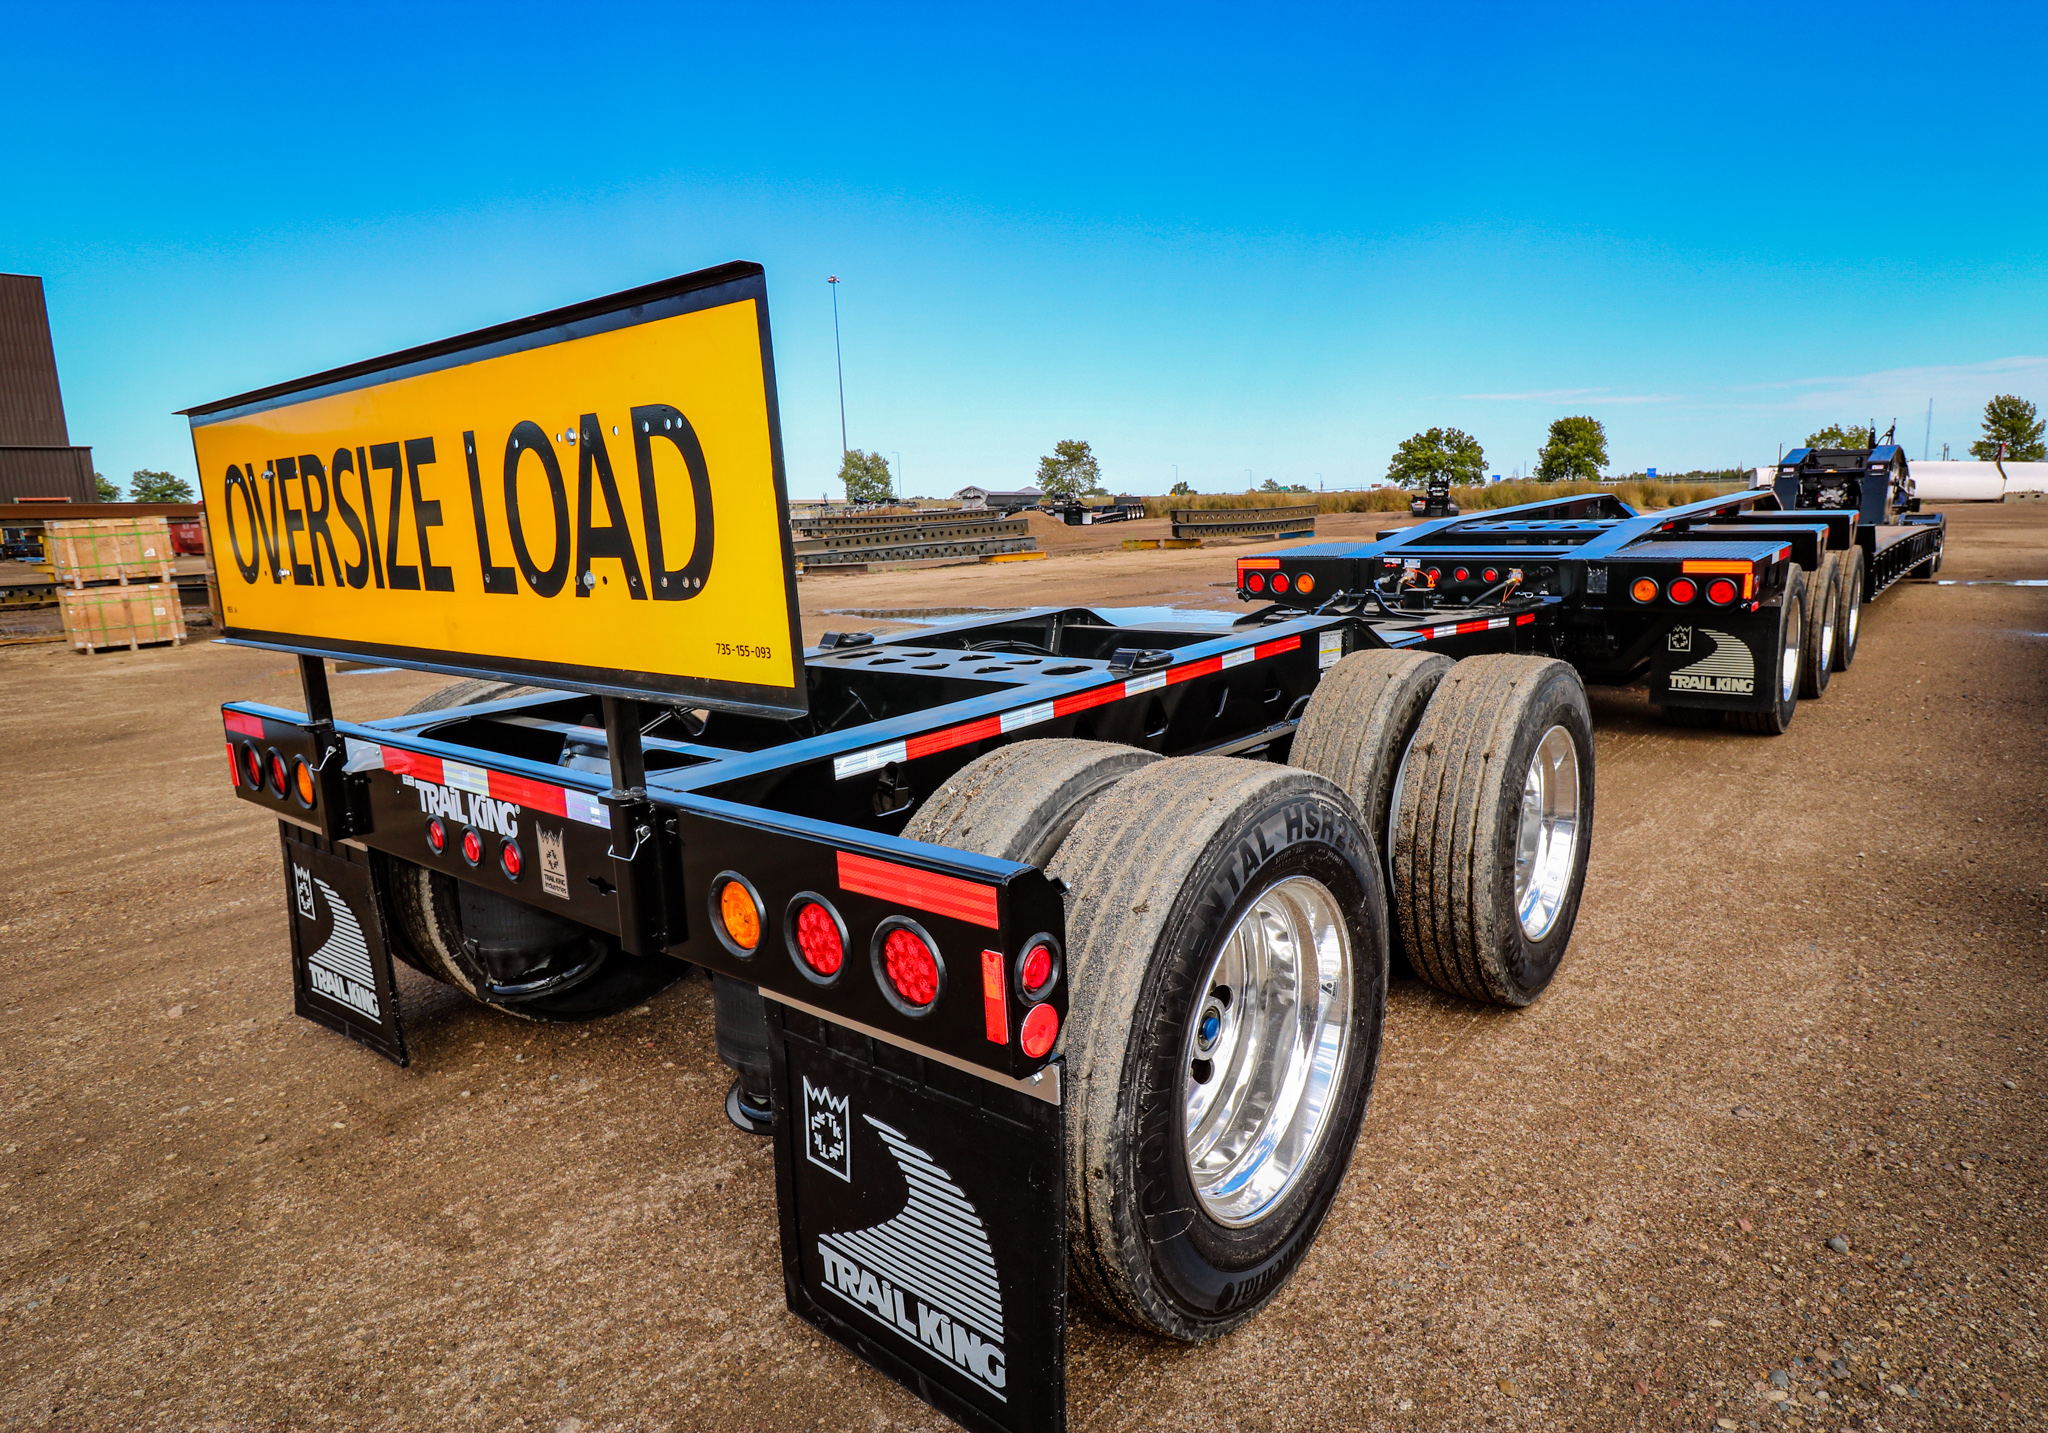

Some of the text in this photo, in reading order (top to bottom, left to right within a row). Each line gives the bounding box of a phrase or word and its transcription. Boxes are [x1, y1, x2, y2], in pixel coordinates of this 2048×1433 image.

[225, 403, 715, 602] OVERSIZE LOAD
[715, 642, 772, 659] 735-155-093
